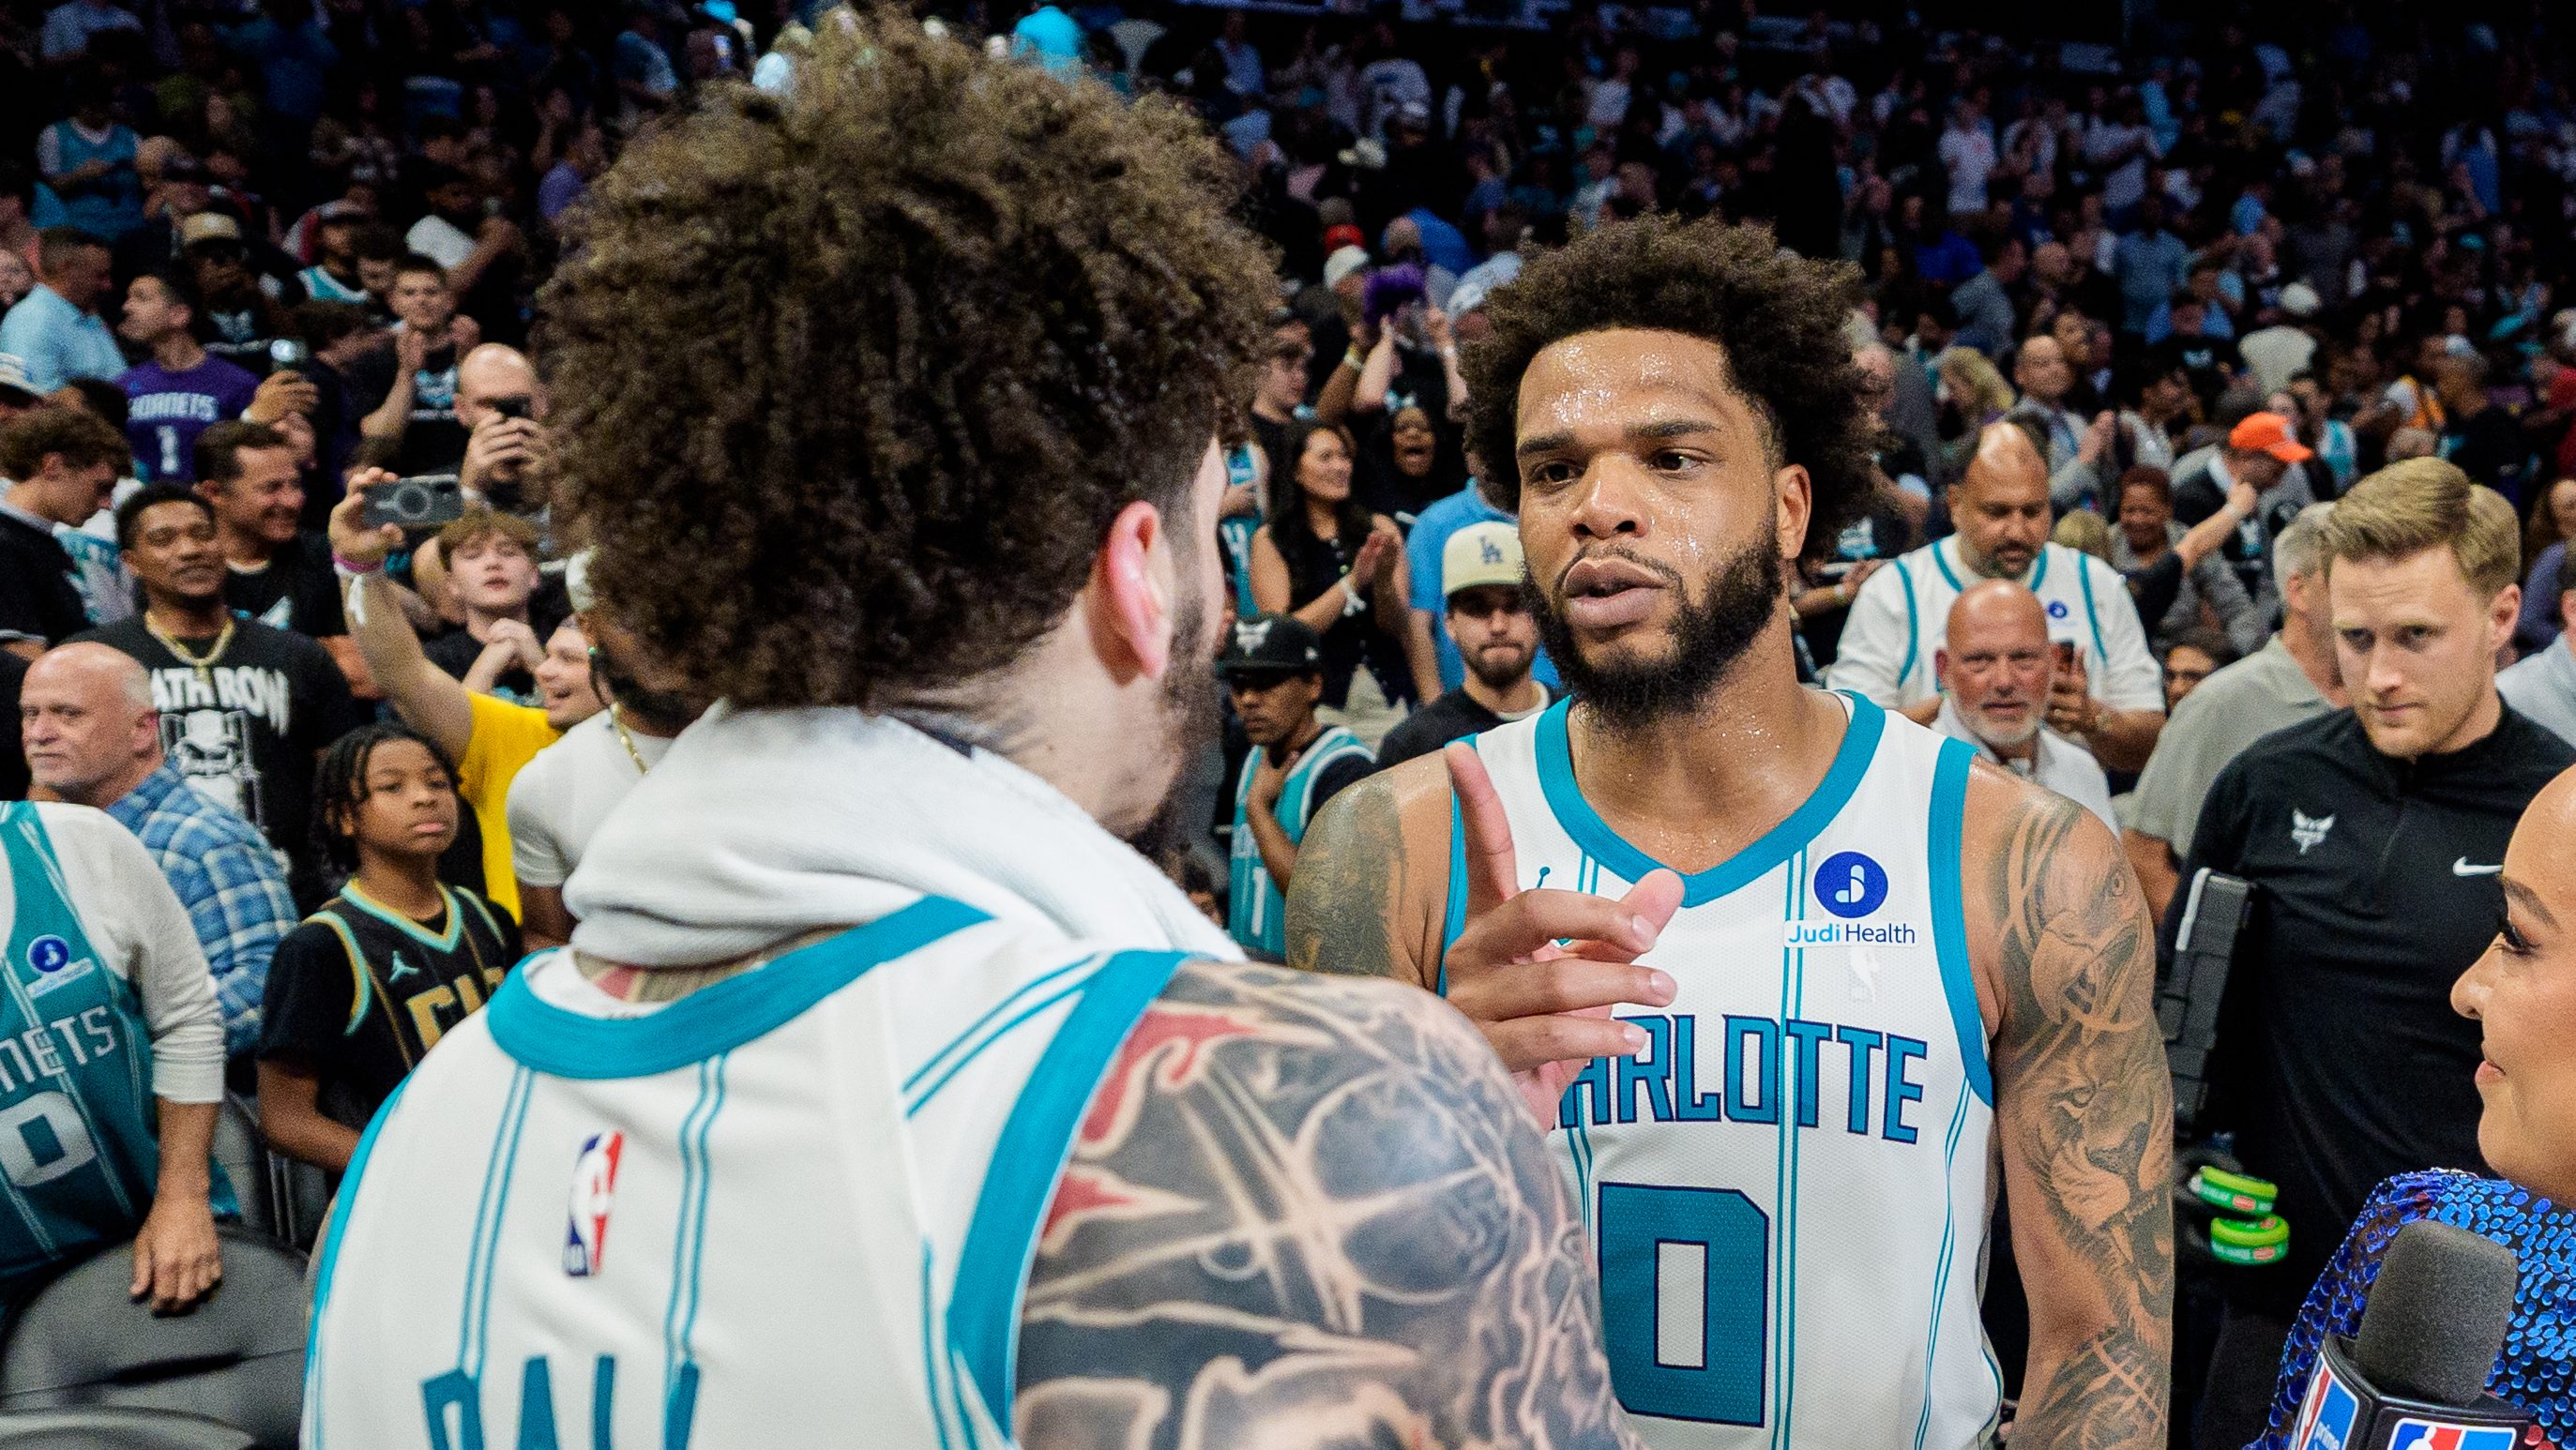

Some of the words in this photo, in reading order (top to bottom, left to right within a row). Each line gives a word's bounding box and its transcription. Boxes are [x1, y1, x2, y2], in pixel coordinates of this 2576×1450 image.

[157, 425, 179, 474] 1
[213, 665, 291, 736] ROW
[1788, 923, 1841, 944] Judi
[1845, 923, 1916, 944] Health
[0, 1005, 116, 1093] NETS
[1553, 1014, 1928, 1145] ARLOTTE
[1598, 1181, 1770, 1428] 0
